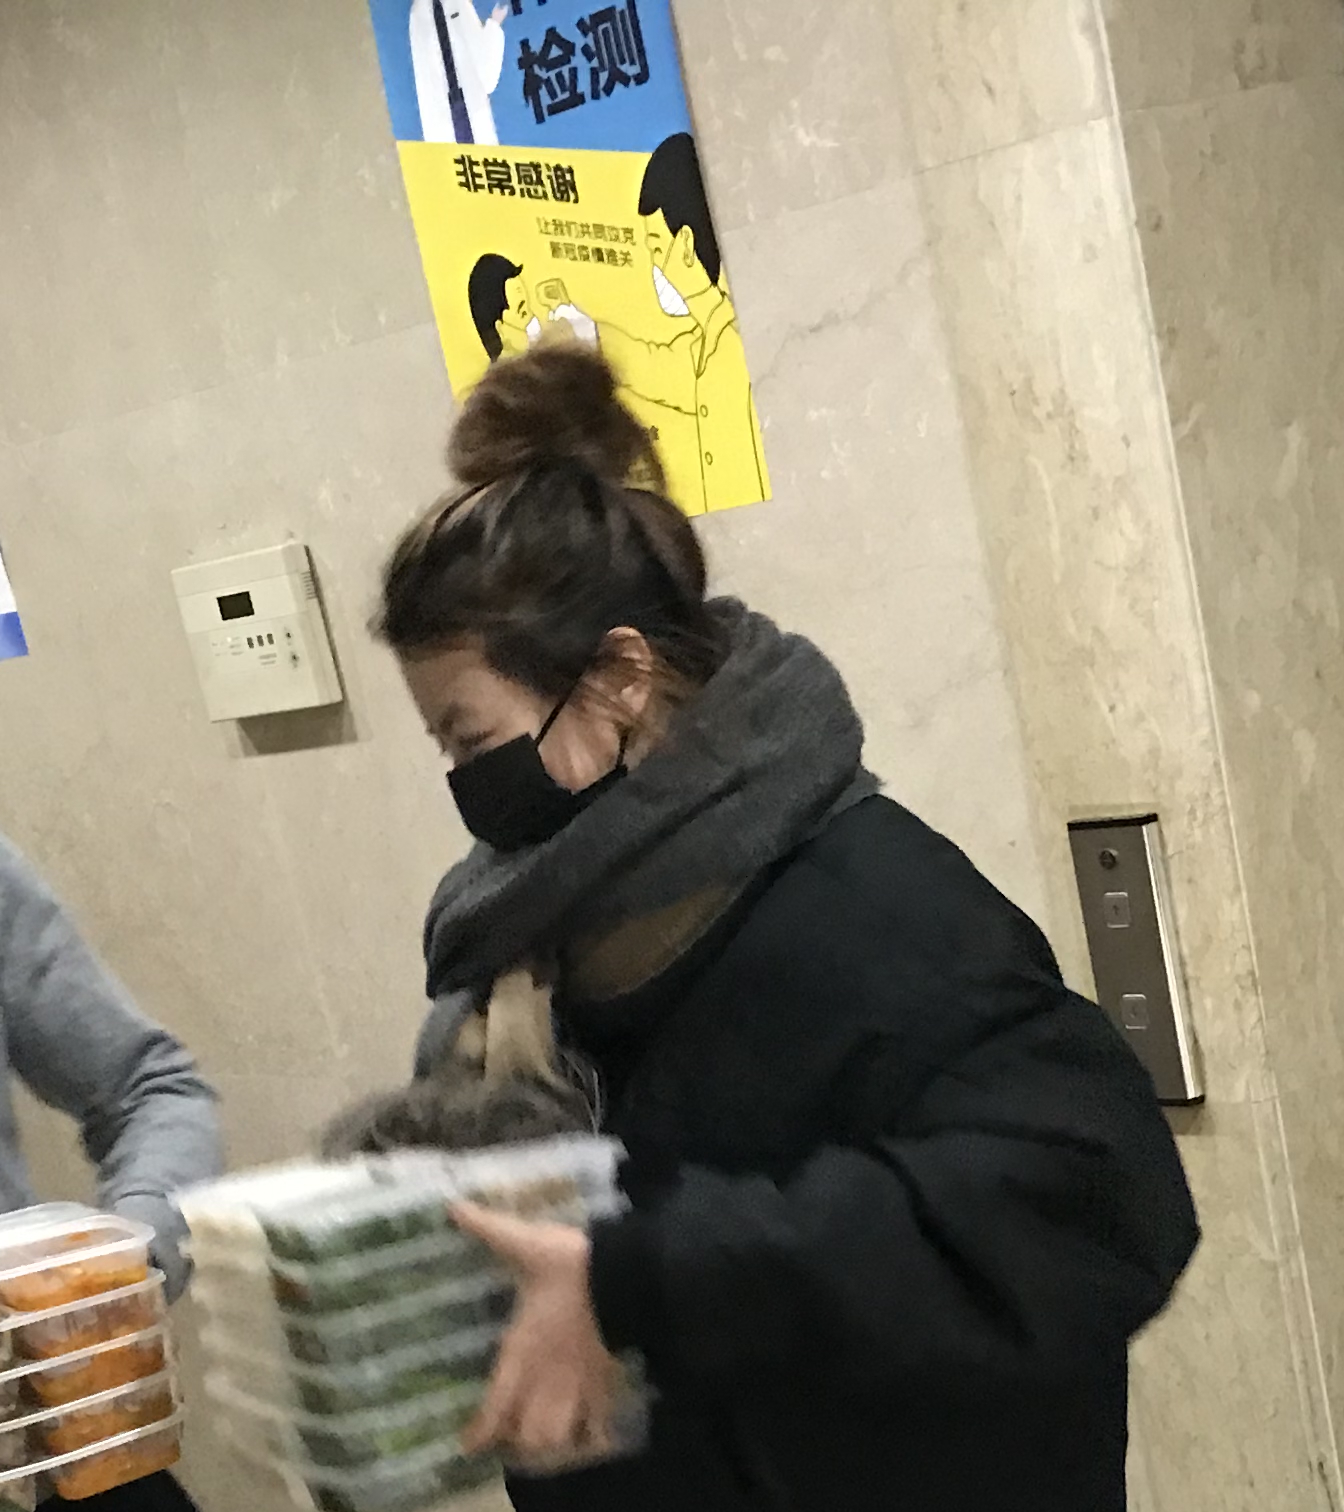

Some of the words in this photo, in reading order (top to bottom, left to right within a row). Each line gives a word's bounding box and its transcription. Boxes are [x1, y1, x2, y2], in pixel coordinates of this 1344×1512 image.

[517, 0, 650, 124] 检测
[453, 154, 580, 204] 非常感谢
